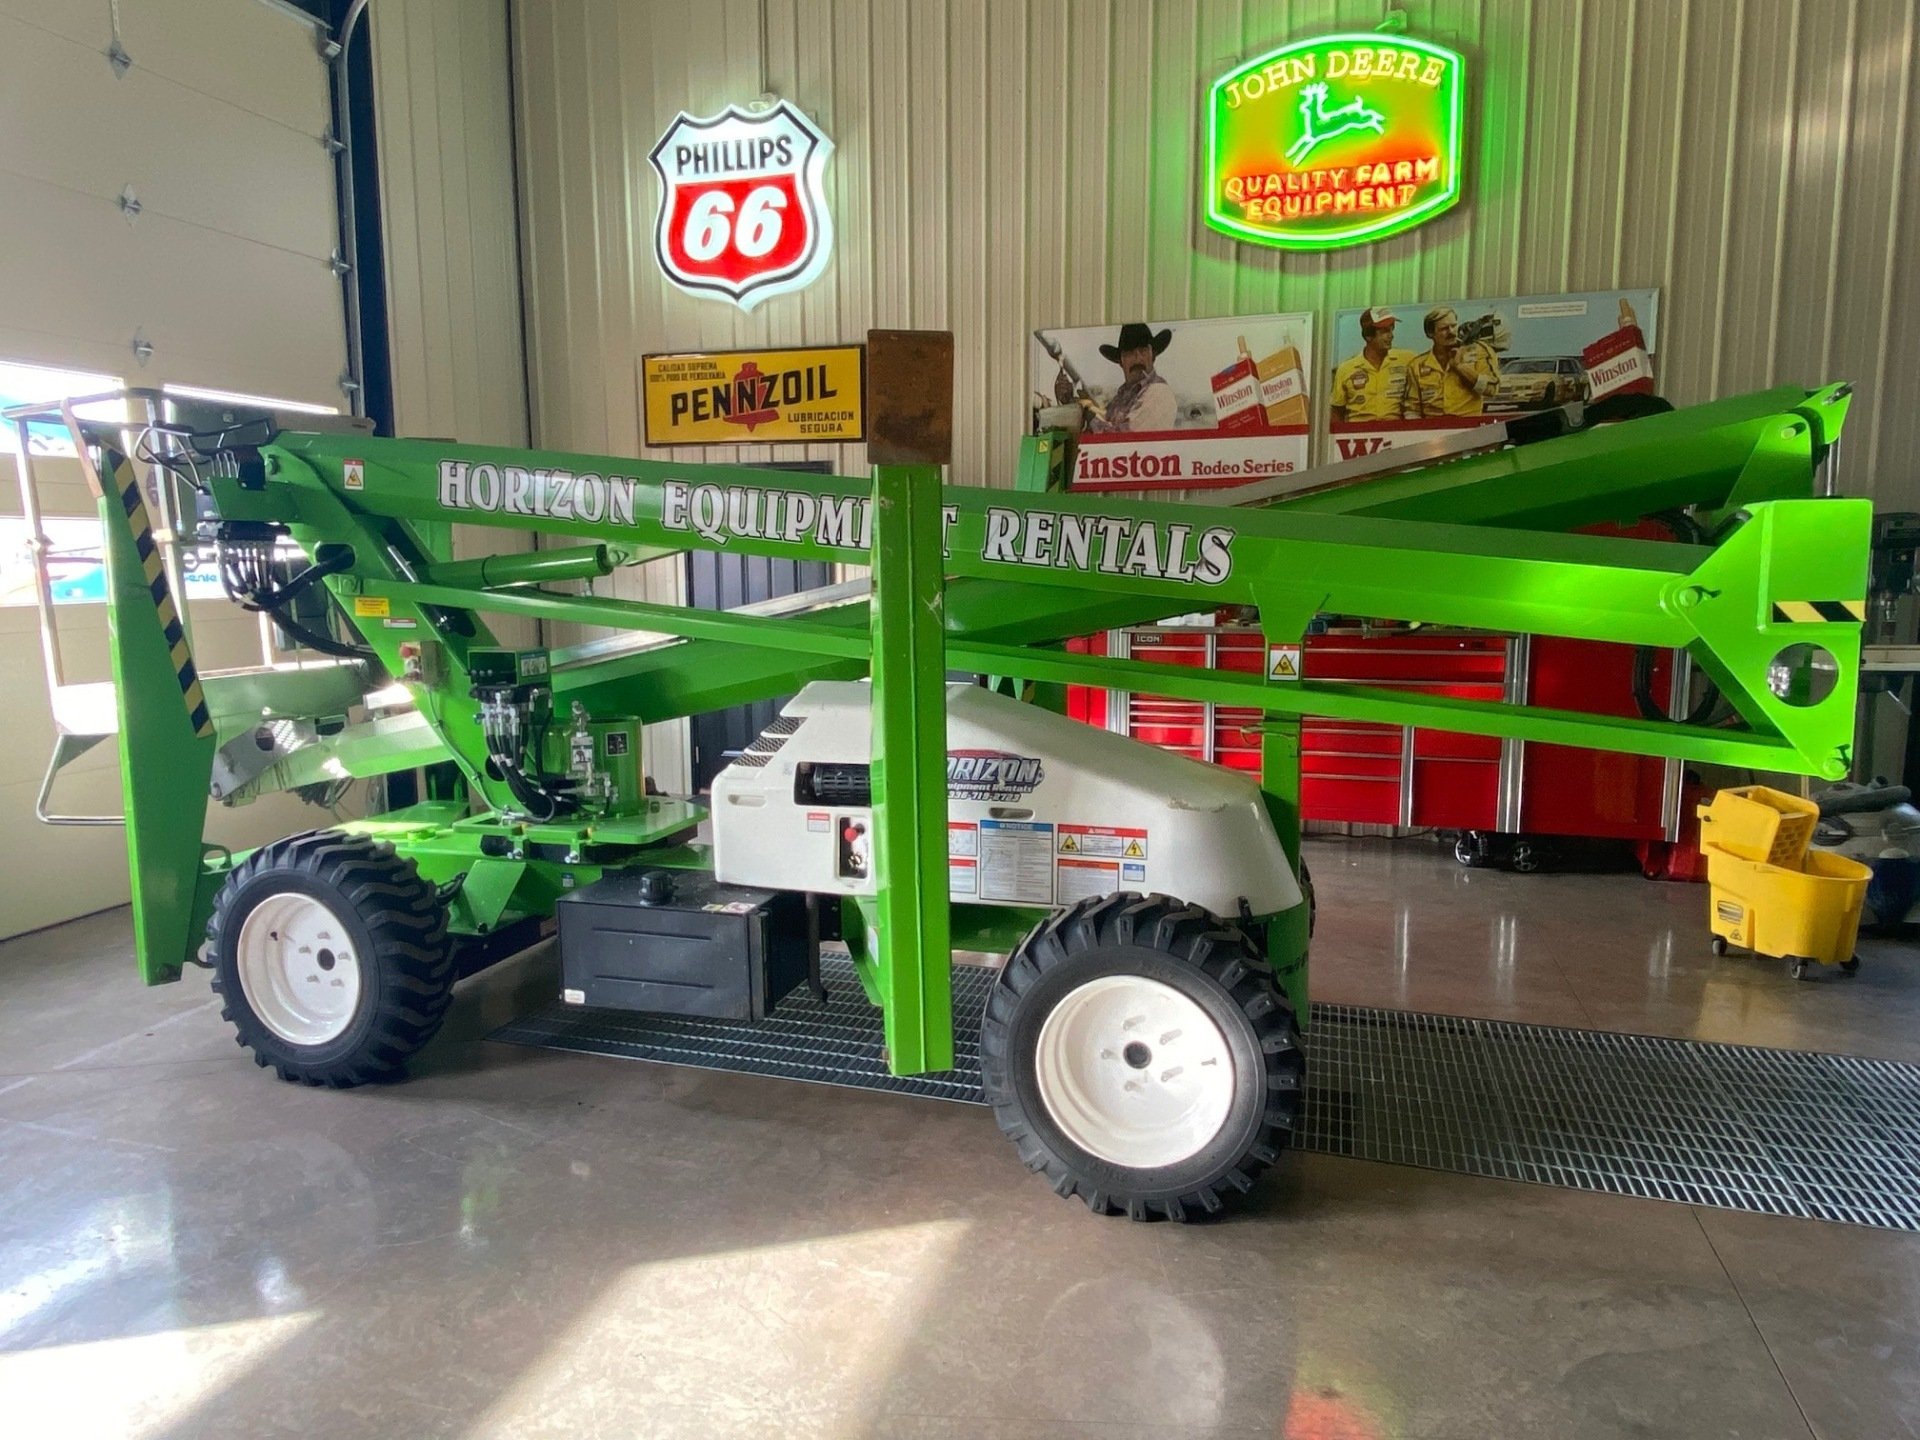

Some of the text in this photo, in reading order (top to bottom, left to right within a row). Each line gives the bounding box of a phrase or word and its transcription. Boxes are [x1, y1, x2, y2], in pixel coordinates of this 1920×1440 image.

[1225, 48, 1446, 108] JOHN DEERE
[675, 134, 792, 176] PHILLIPS
[1224, 157, 1440, 200] QUALITY FARM
[1240, 184, 1417, 222] EQUIPMENT
[683, 186, 788, 262] 66
[1262, 377, 1293, 396] Winston
[1590, 357, 1637, 387] Winston
[671, 364, 838, 426] PENNZOIL
[1217, 384, 1253, 409] Winston
[787, 410, 854, 423] LUBRICACION
[800, 423, 843, 433] SEGURA
[1079, 450, 1294, 479] inston Rodeo Series
[438, 460, 639, 527] HORIZON
[983, 506, 1237, 587] RENTALS
[1136, 635, 1160, 643] ICON
